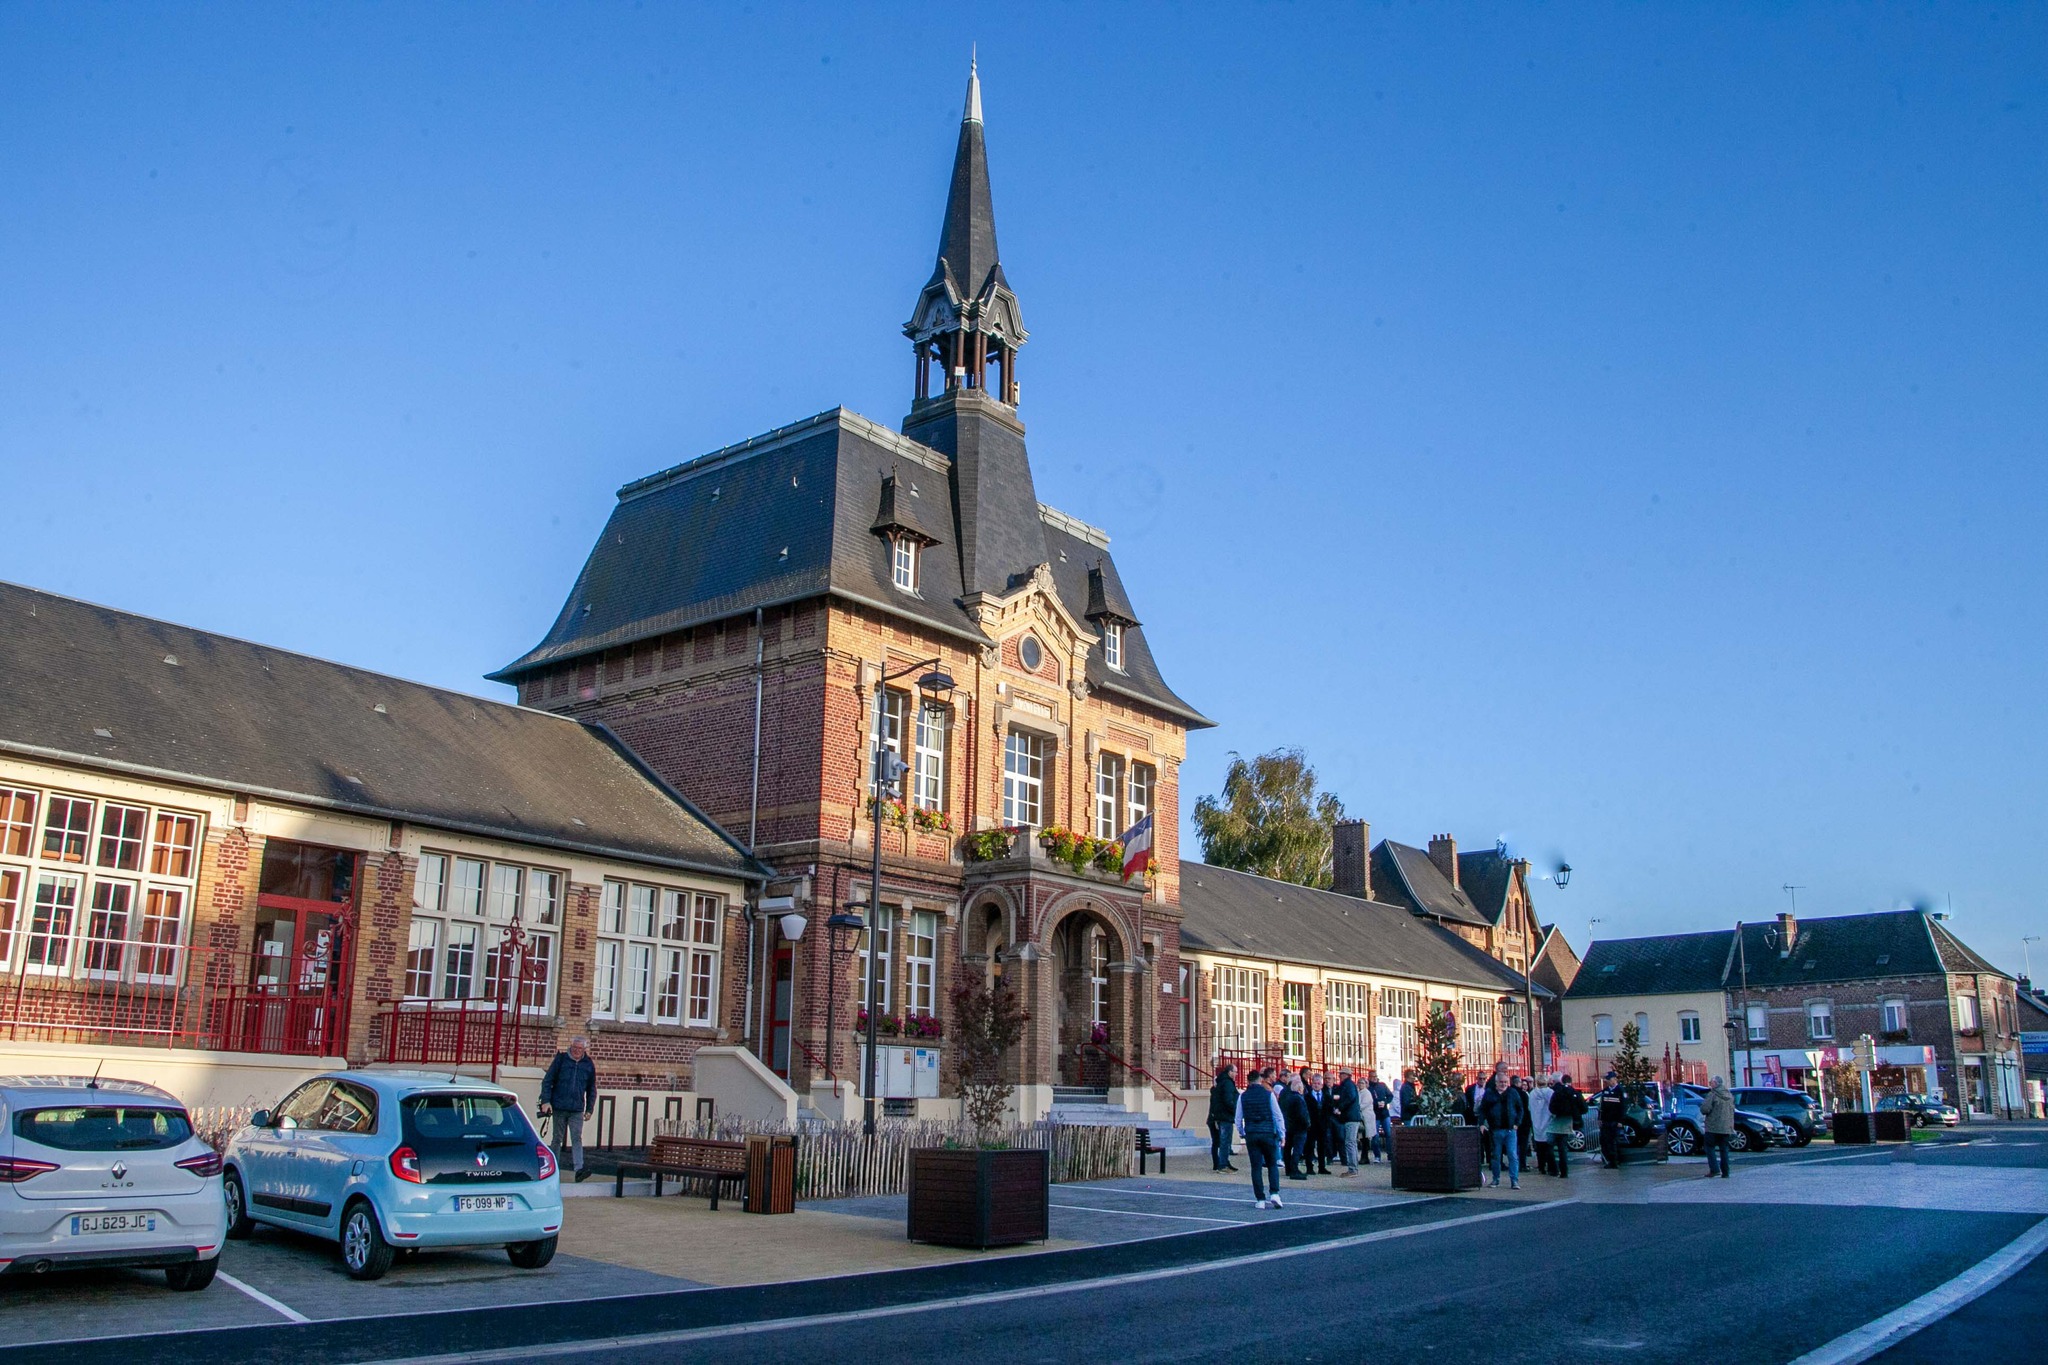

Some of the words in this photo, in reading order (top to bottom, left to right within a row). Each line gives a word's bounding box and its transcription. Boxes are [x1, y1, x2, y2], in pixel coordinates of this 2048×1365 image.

[1013, 695, 1051, 718] MAIRIE
[460, 1197, 506, 1210] FG-099-NP
[82, 1215, 146, 1231] GJ-629-JC
